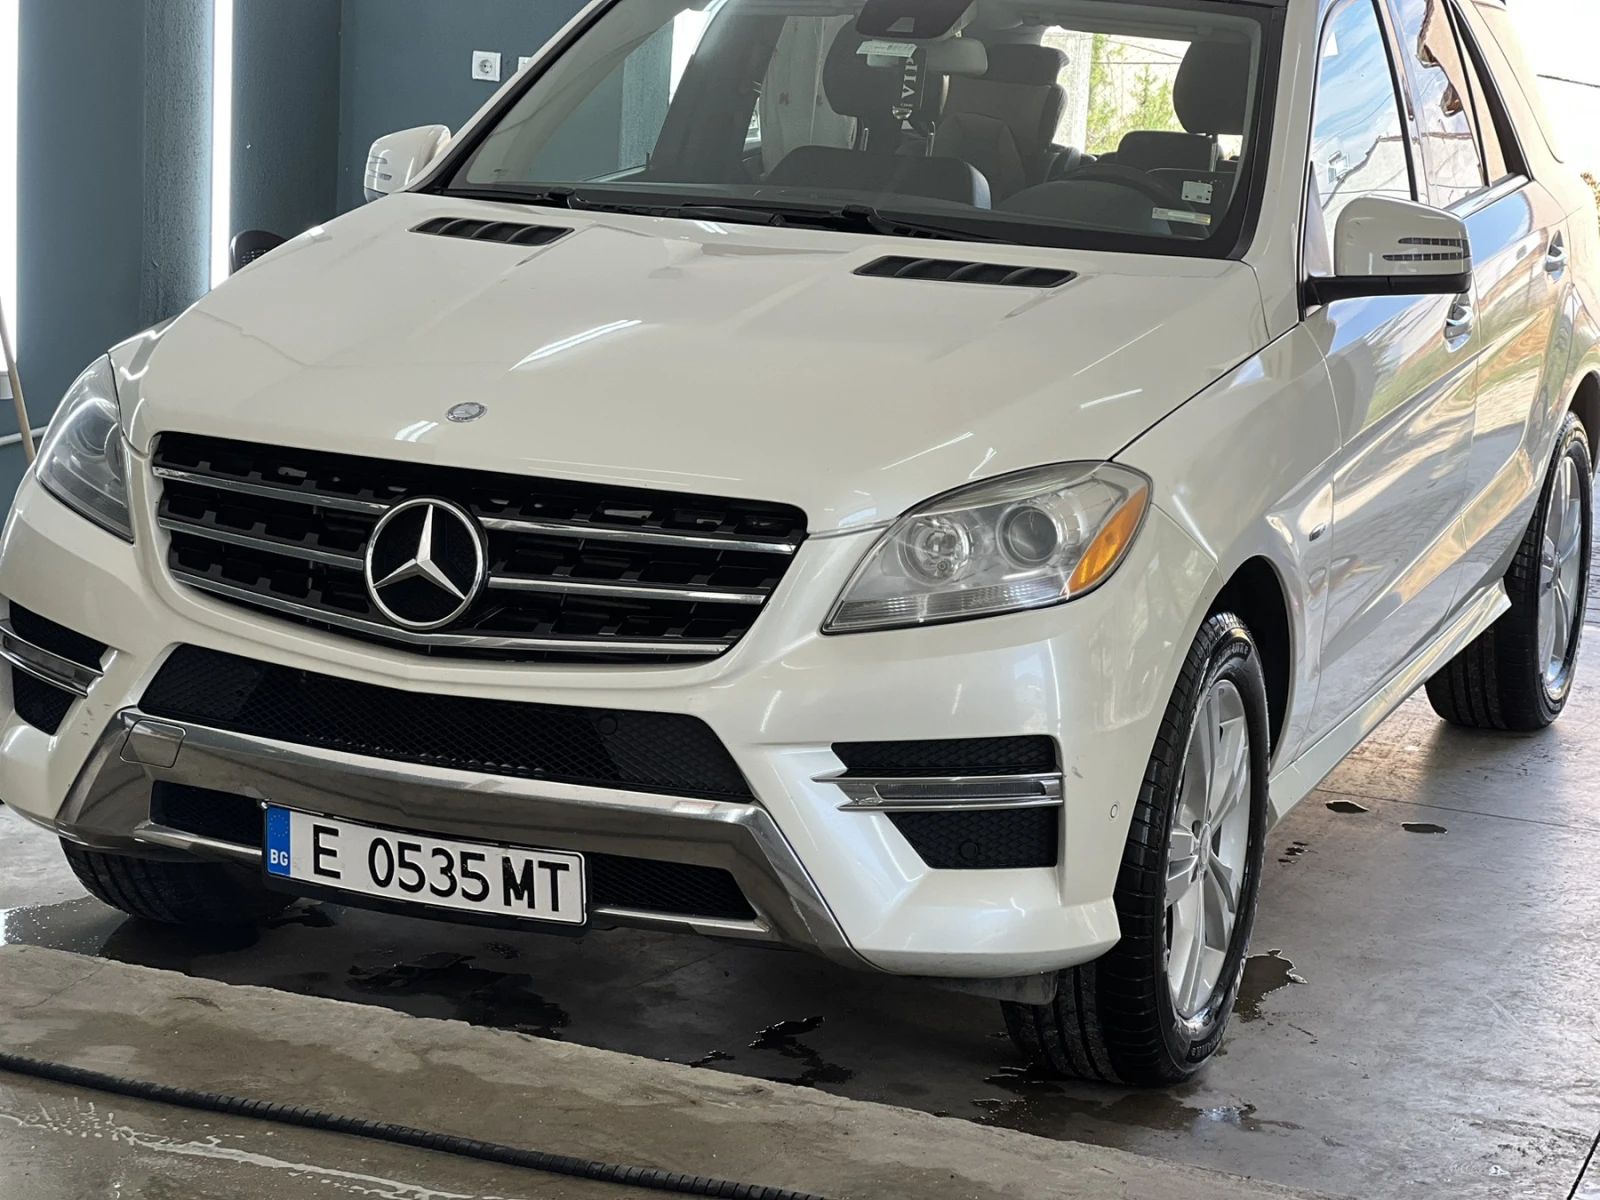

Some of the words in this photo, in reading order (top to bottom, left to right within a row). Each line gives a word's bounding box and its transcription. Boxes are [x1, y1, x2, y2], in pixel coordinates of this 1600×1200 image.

[270, 848, 289, 867] BG
[312, 823, 341, 880] E
[368, 837, 490, 902] 0535
[502, 855, 570, 912] MT
